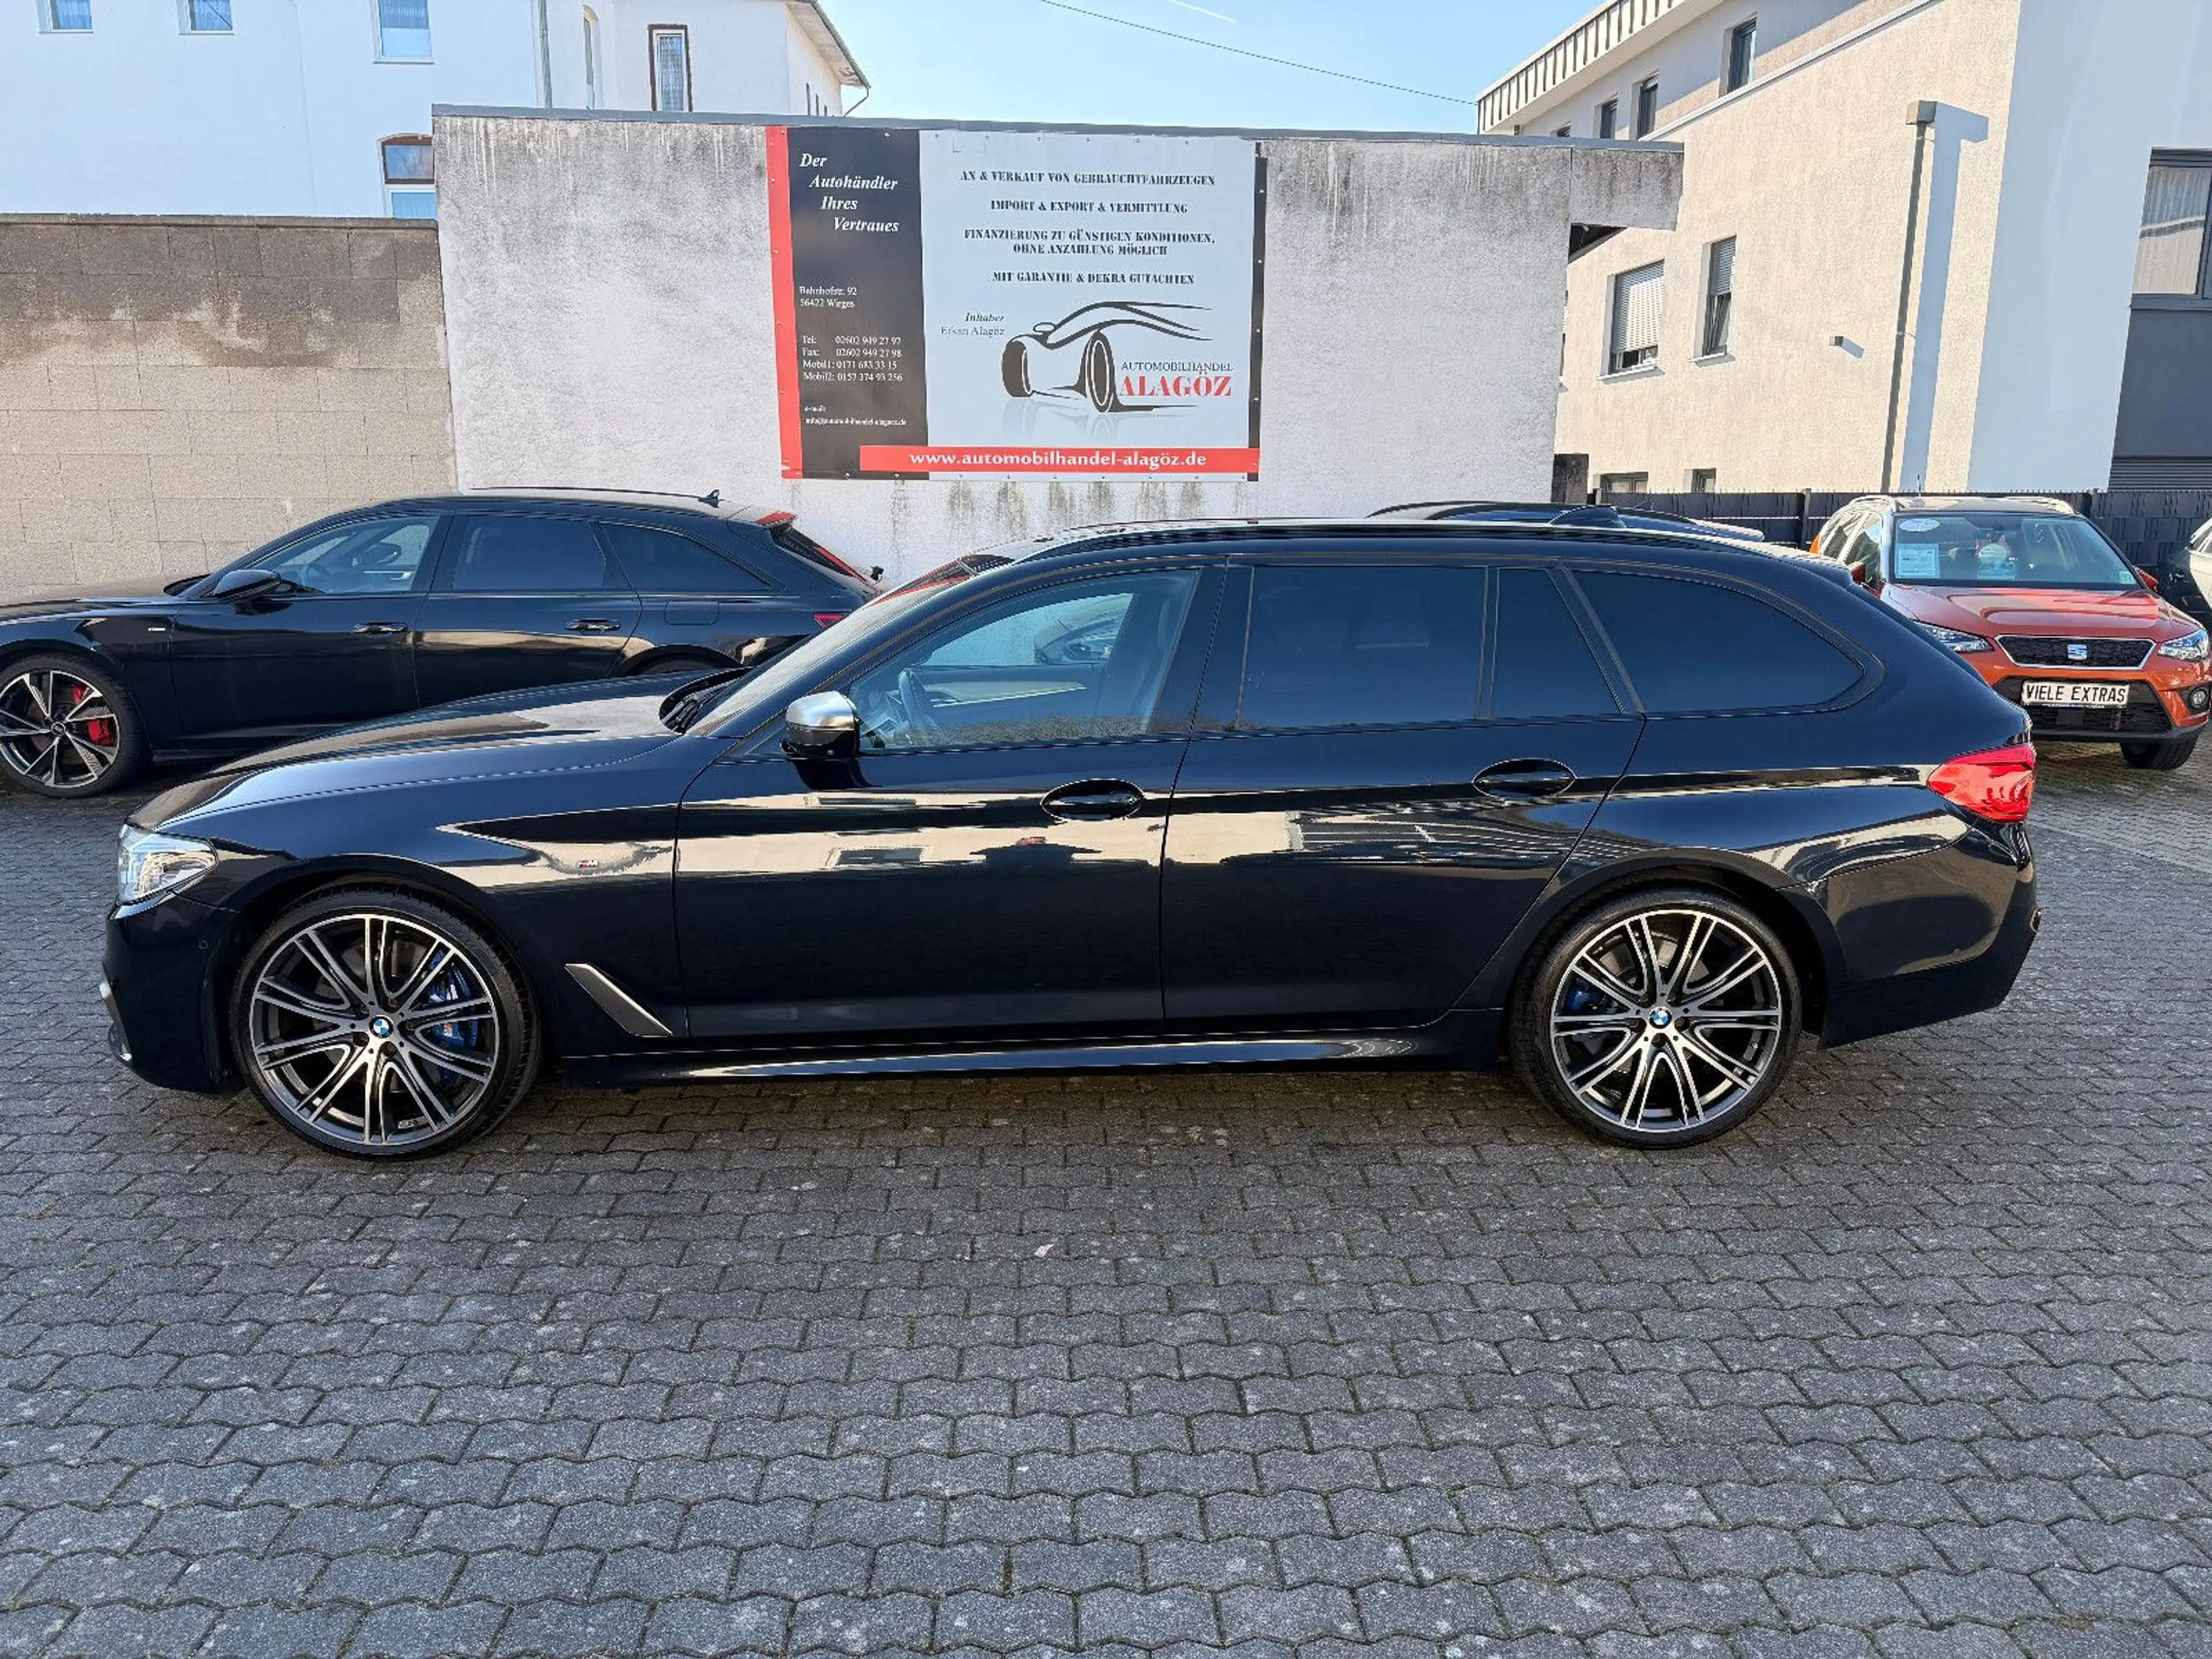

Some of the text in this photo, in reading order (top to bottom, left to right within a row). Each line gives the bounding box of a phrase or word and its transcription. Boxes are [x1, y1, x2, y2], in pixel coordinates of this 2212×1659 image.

[799, 153, 827, 167] Der
[809, 174, 898, 190] Autohändler
[960, 171, 1215, 185] AN & VERKAUF VON GEBRAUCHTFAHRZEUGEN
[820, 196, 858, 210] Ihres
[991, 200, 1187, 213] IMPORT & EXPORT & VERMITTLUNG
[964, 229, 1215, 244] FINANZIERUNG ZU GÜNSTIGEN KONDITIONEN,
[1013, 243, 1168, 255] OHNE ANZAHLUNG MÖGLICH
[993, 272, 1194, 285] MIT GARANTIE & DEKRA GUTACHTEN
[847, 286, 857, 296] 92
[965, 312, 1005, 322] Inhaber
[971, 326, 1005, 338] Alagöz
[862, 348, 877, 357] 949
[836, 361, 855, 369] 0171
[1121, 362, 1233, 372] AUTOMOBILHANDEL
[1119, 371, 1232, 397] ALAGÖZ
[909, 452, 1207, 470] www.automobilhandel-alagöz.de
[2027, 684, 2126, 703] VIELE EXTRAS
